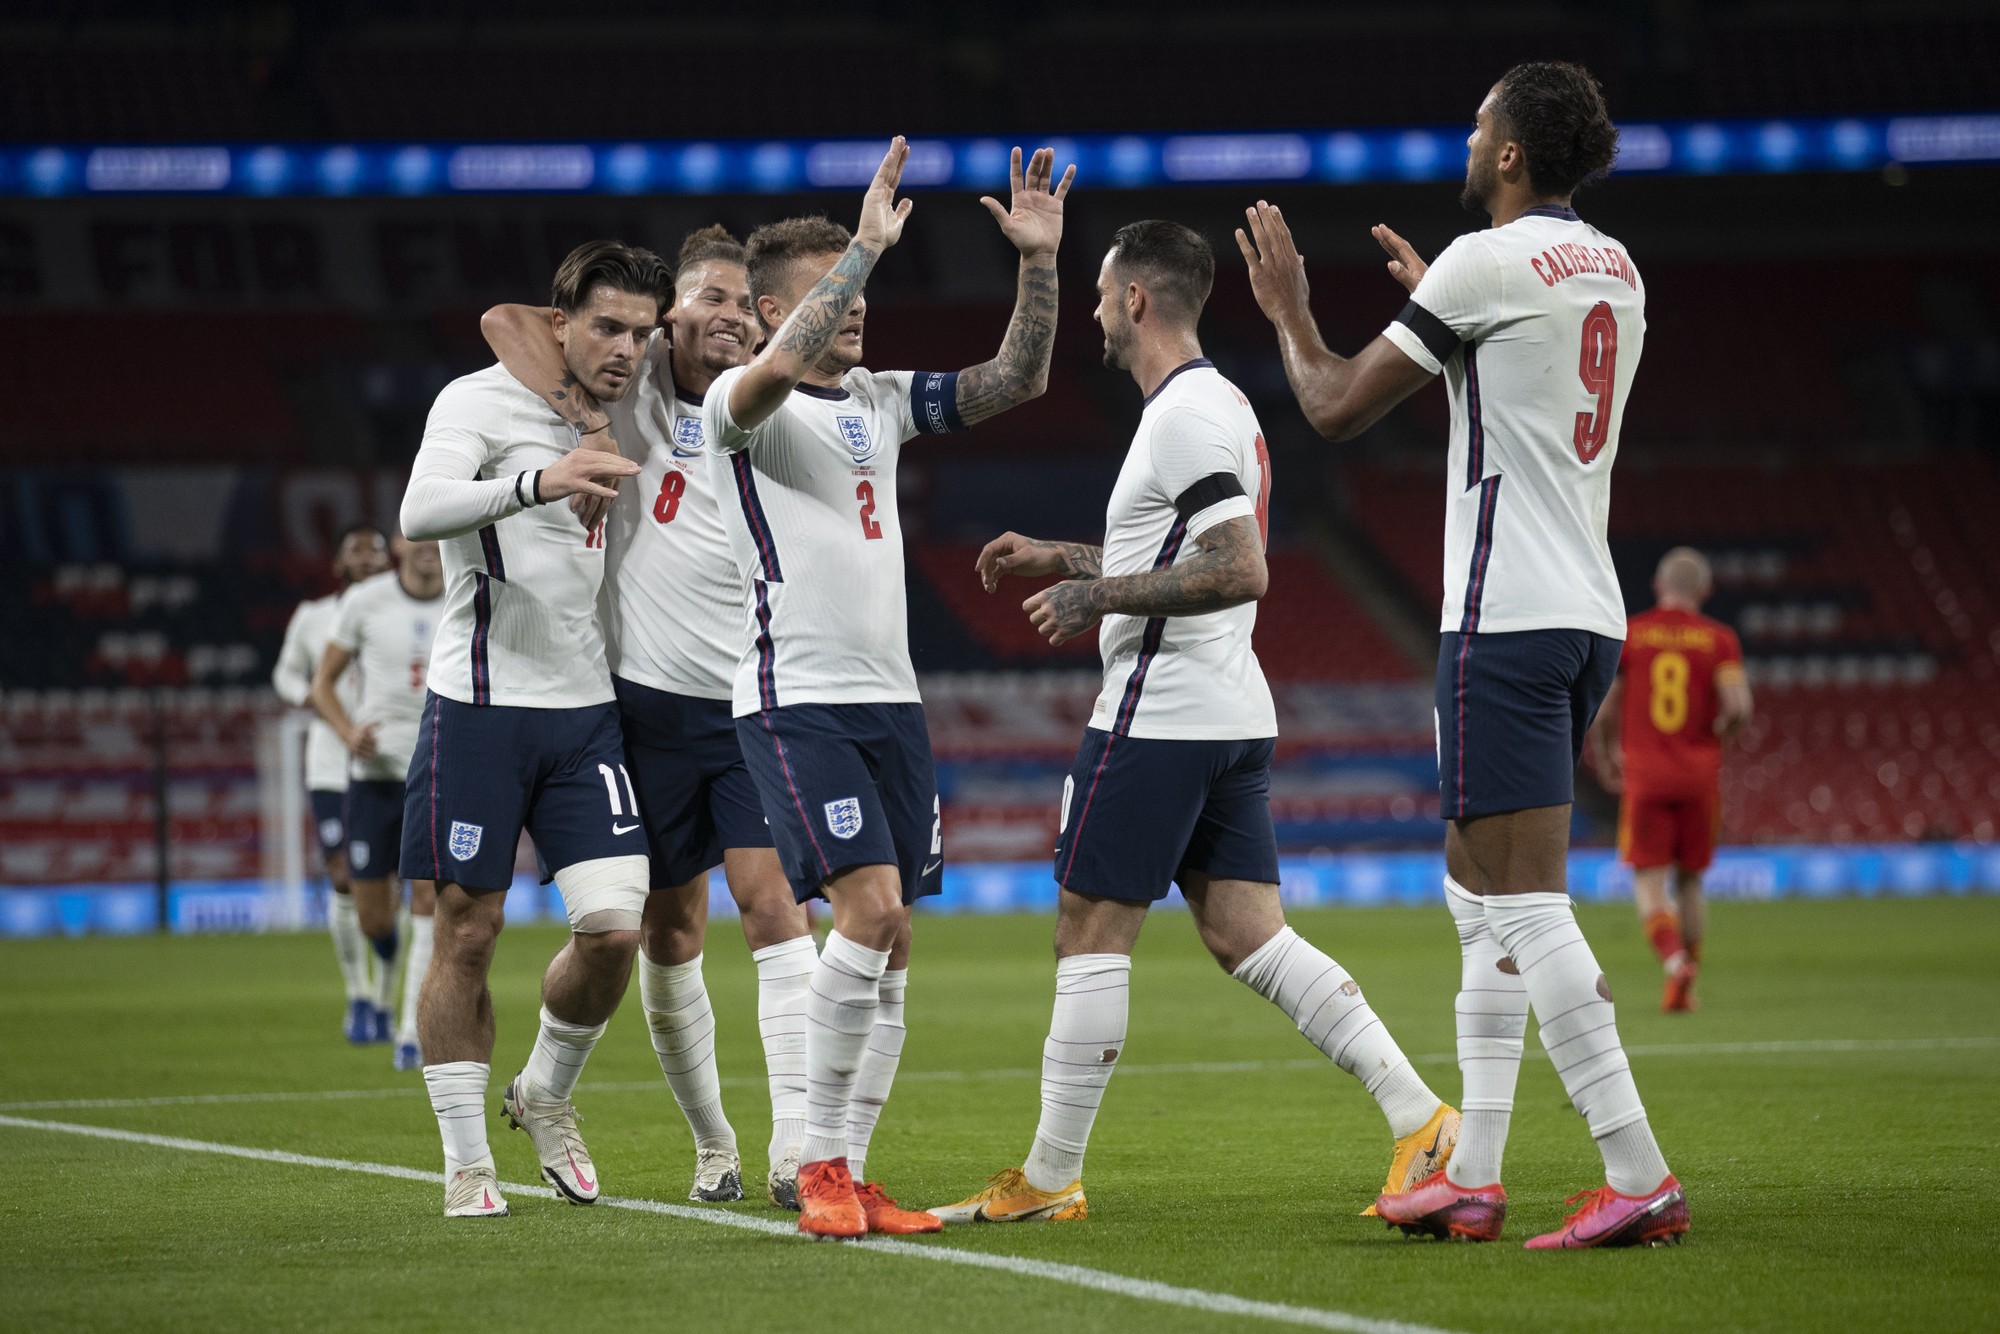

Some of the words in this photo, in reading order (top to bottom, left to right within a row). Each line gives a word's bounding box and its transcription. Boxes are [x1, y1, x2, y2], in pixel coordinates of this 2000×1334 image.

[1573, 301, 1618, 464] 9
[928, 402, 946, 434] ESPECT
[653, 470, 686, 524] 8
[856, 480, 884, 540] 2
[1649, 651, 1689, 734] 8
[598, 763, 639, 817] 11
[930, 792, 942, 855] 2
